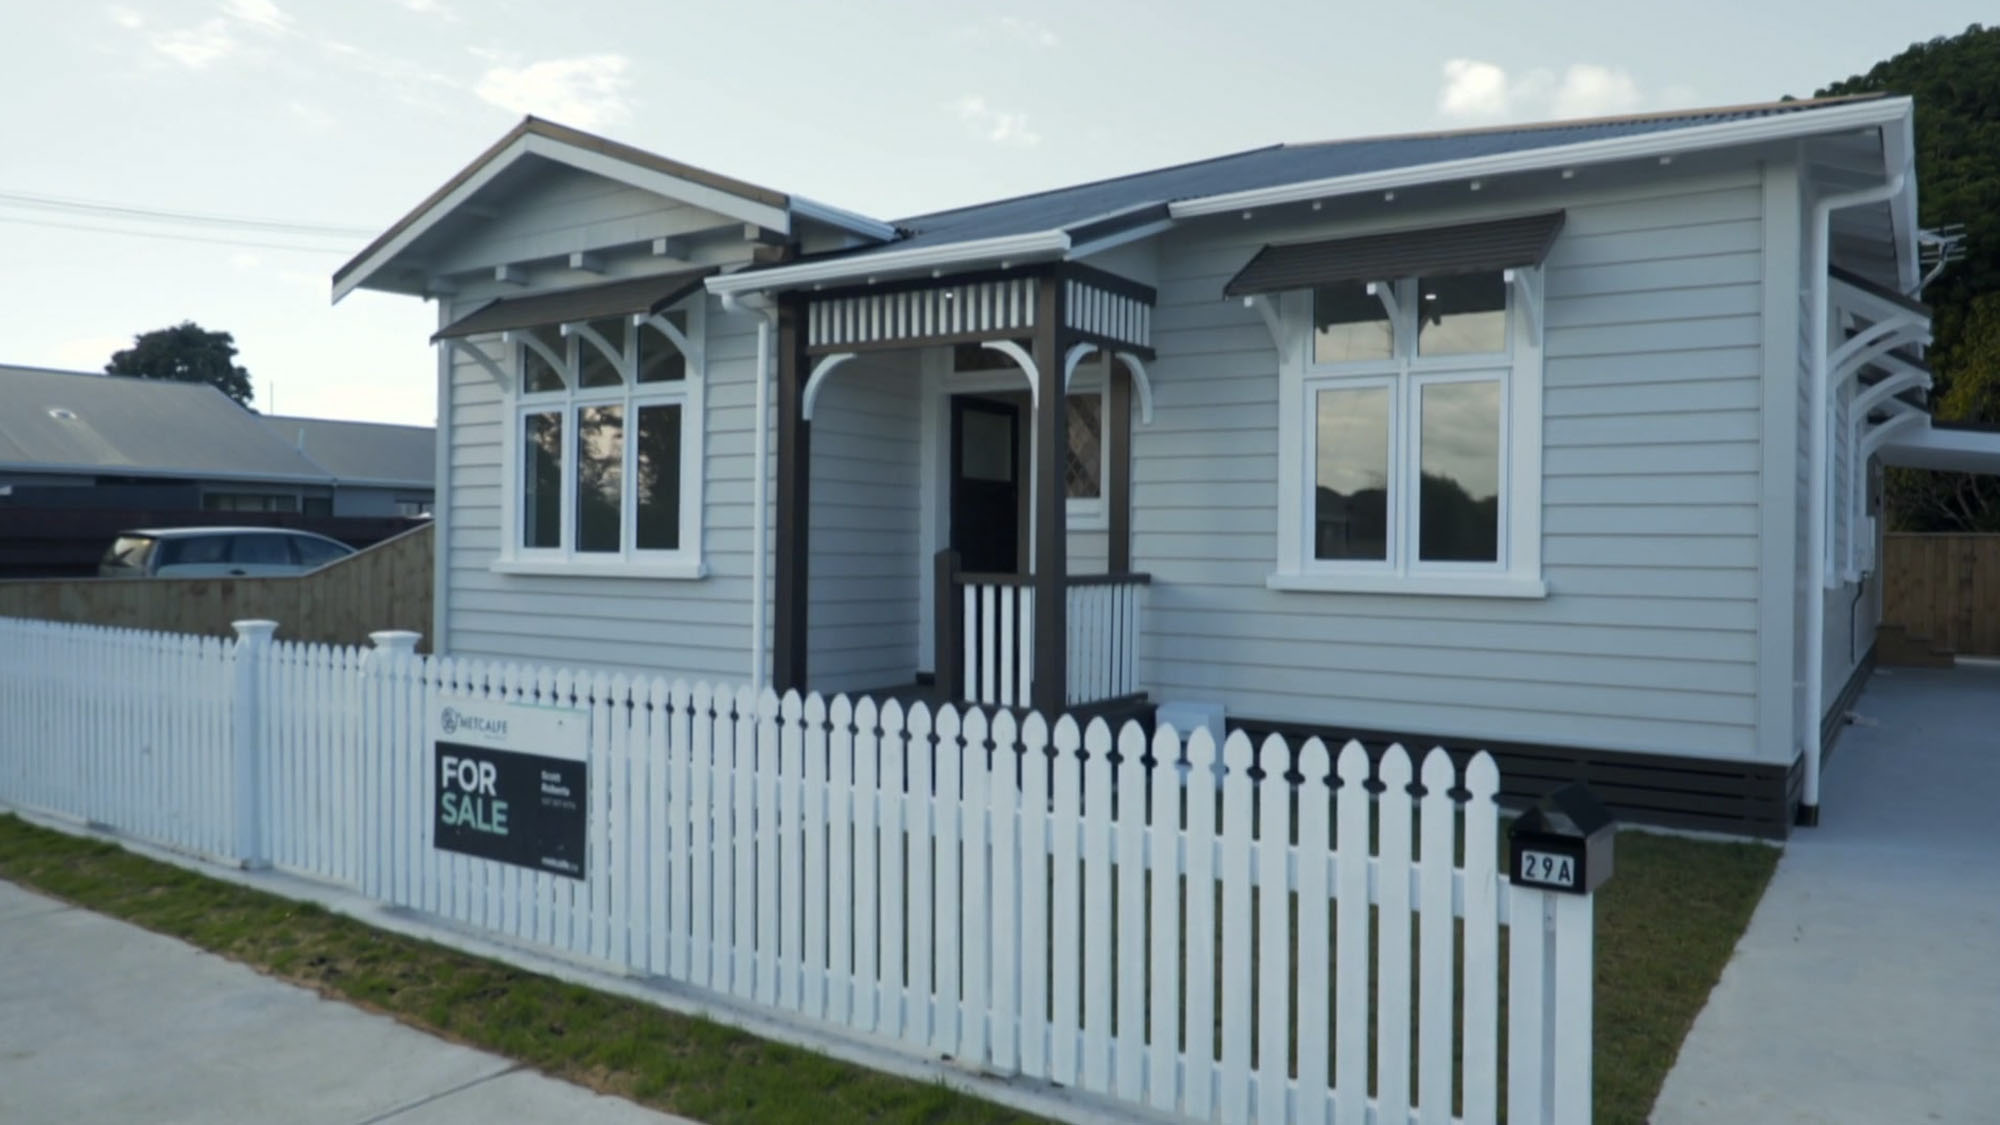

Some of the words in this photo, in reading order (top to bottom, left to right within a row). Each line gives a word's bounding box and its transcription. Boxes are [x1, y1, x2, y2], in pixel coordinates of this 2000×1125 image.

[441, 756, 496, 796] FOR
[441, 793, 508, 835] SALE
[1525, 855, 1571, 882] 29A
